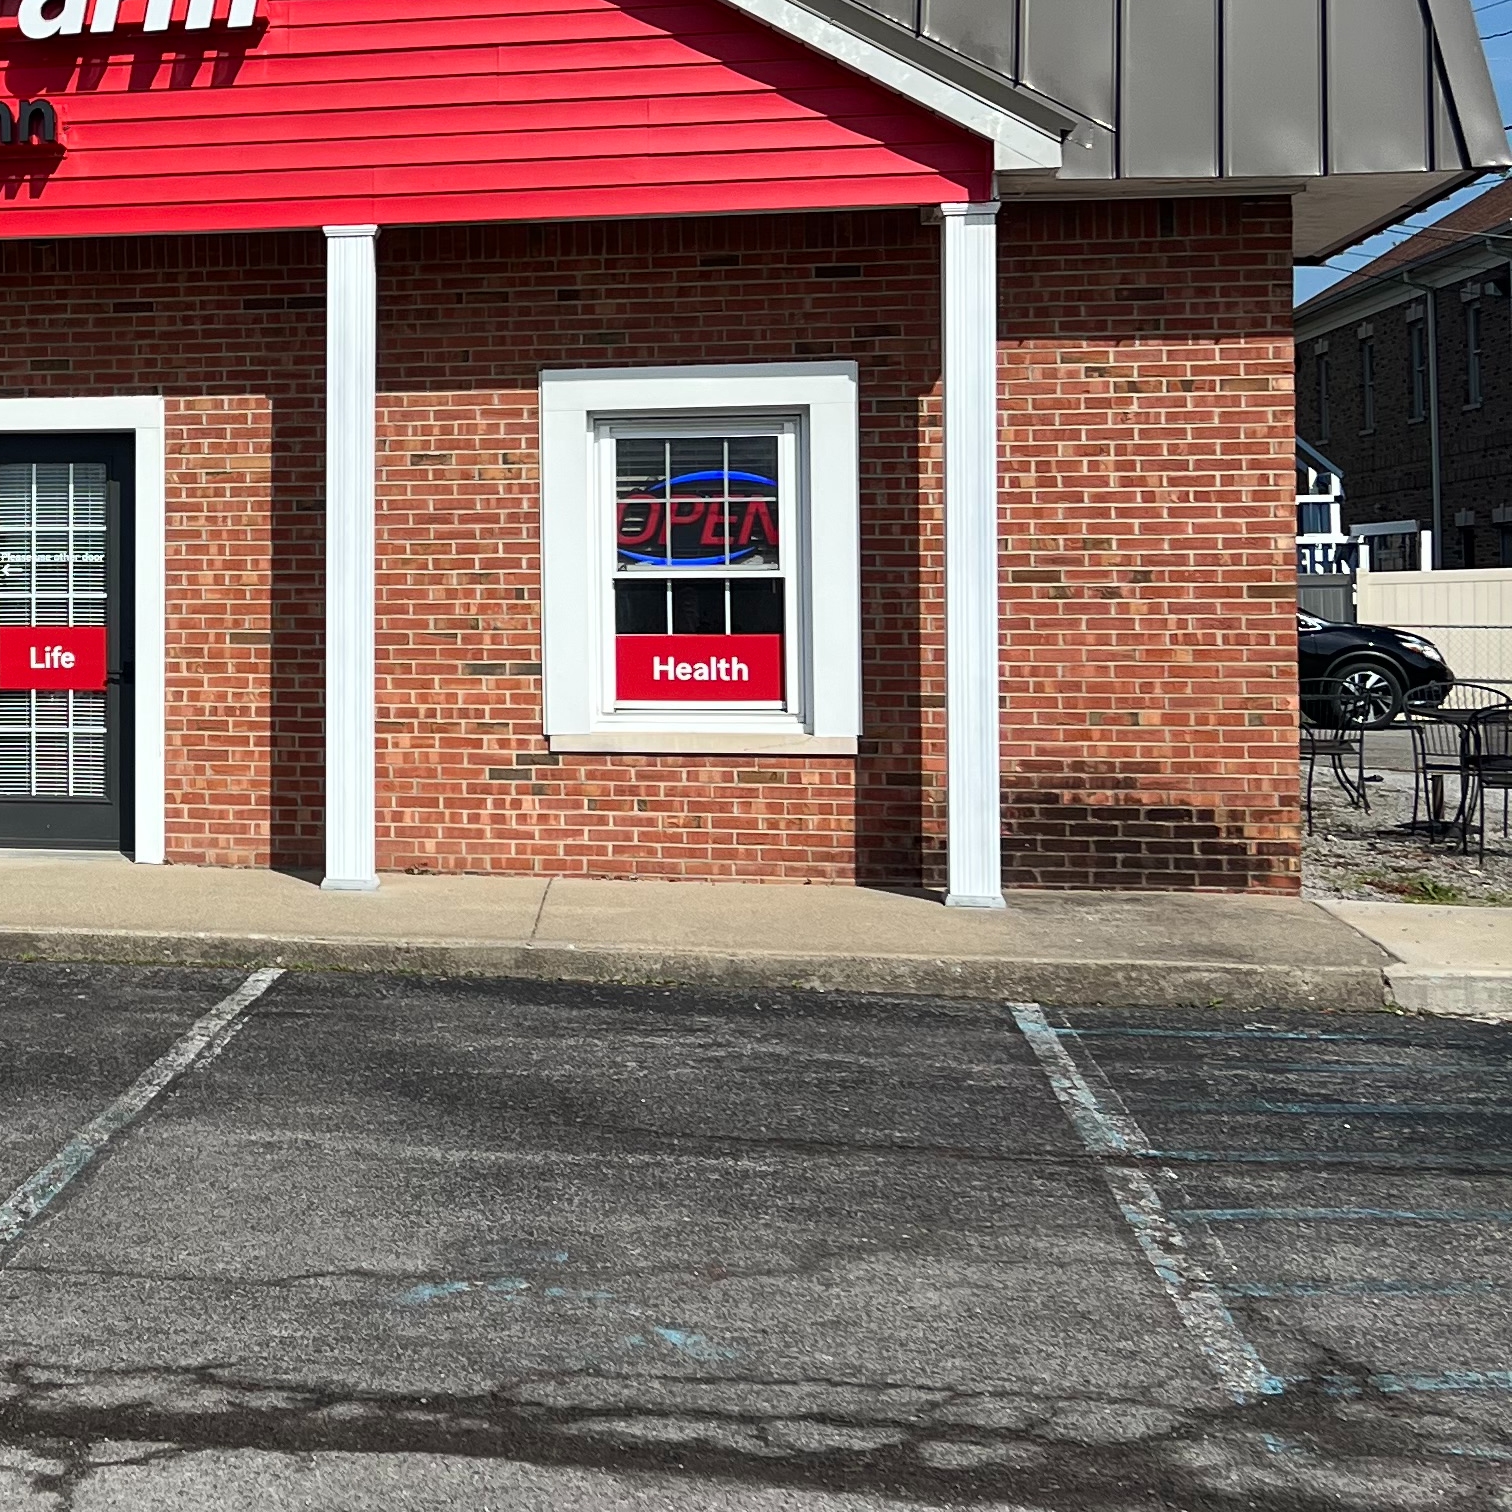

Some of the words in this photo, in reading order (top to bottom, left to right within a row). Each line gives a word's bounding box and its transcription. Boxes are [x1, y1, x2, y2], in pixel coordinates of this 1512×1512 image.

[616, 492, 779, 546] OPEN
[30, 645, 75, 669] Life
[652, 655, 749, 681] Health
